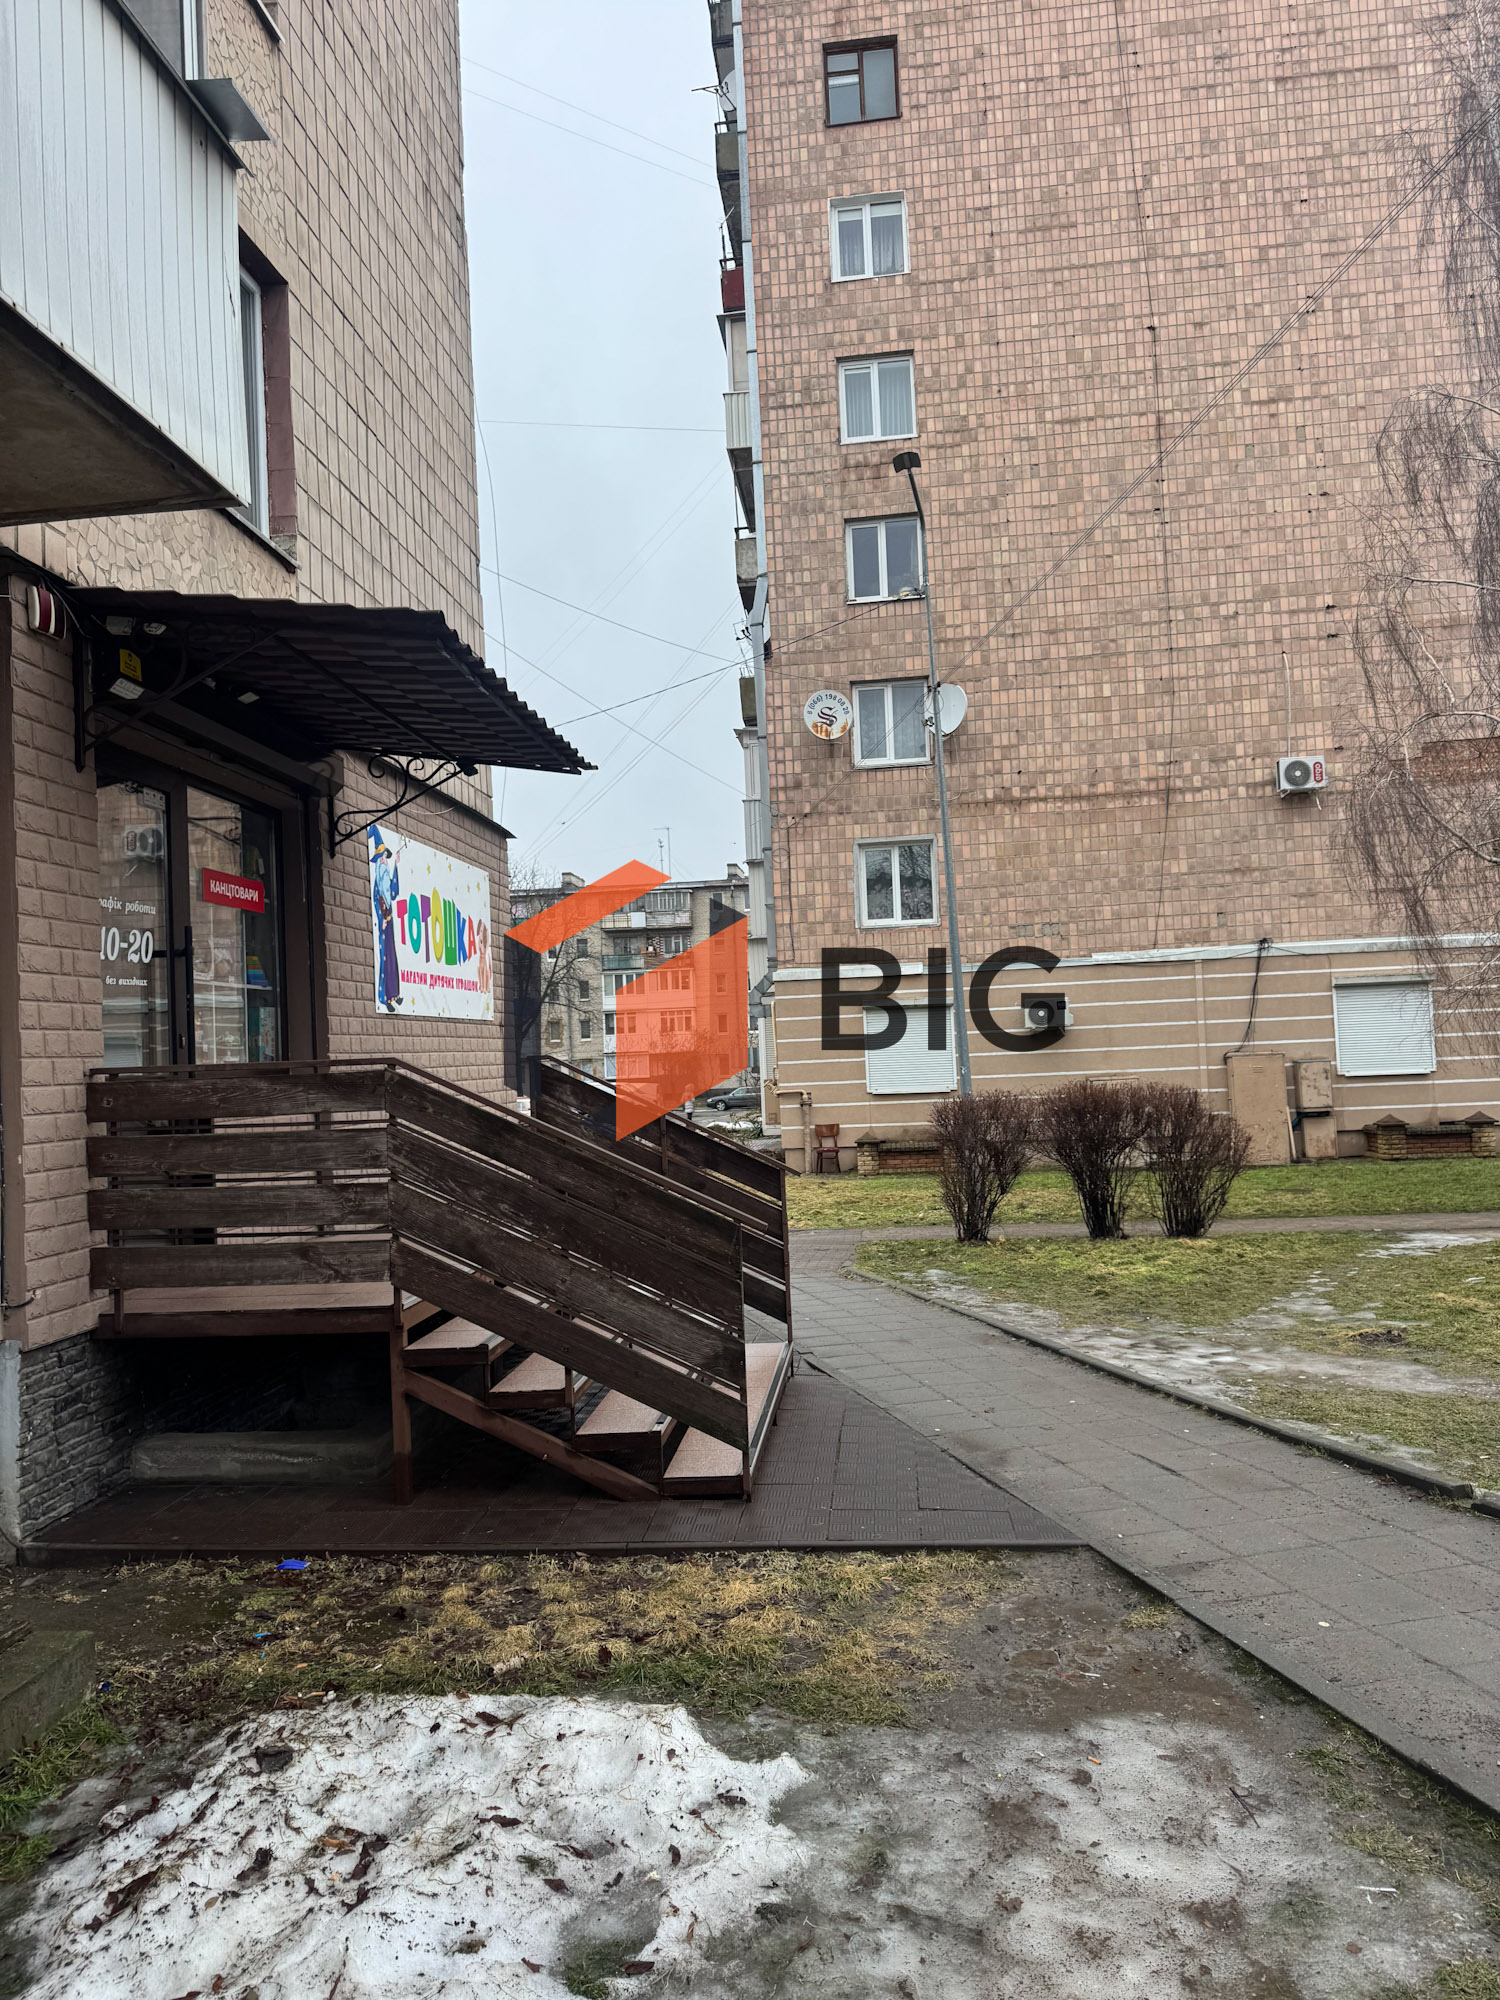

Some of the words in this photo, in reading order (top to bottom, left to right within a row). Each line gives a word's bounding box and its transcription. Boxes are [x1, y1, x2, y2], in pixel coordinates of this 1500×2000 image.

[210, 879, 259, 903] КАНЦТОВАРИ
[125, 901, 156, 915] роботи
[396, 887, 478, 967] ТОТОШКА
[100, 926, 154, 964] 10-20
[105, 975, 117, 985] без
[401, 969, 427, 986] МАГАЗИН
[429, 974, 454, 990] ДИТЯЧИХ
